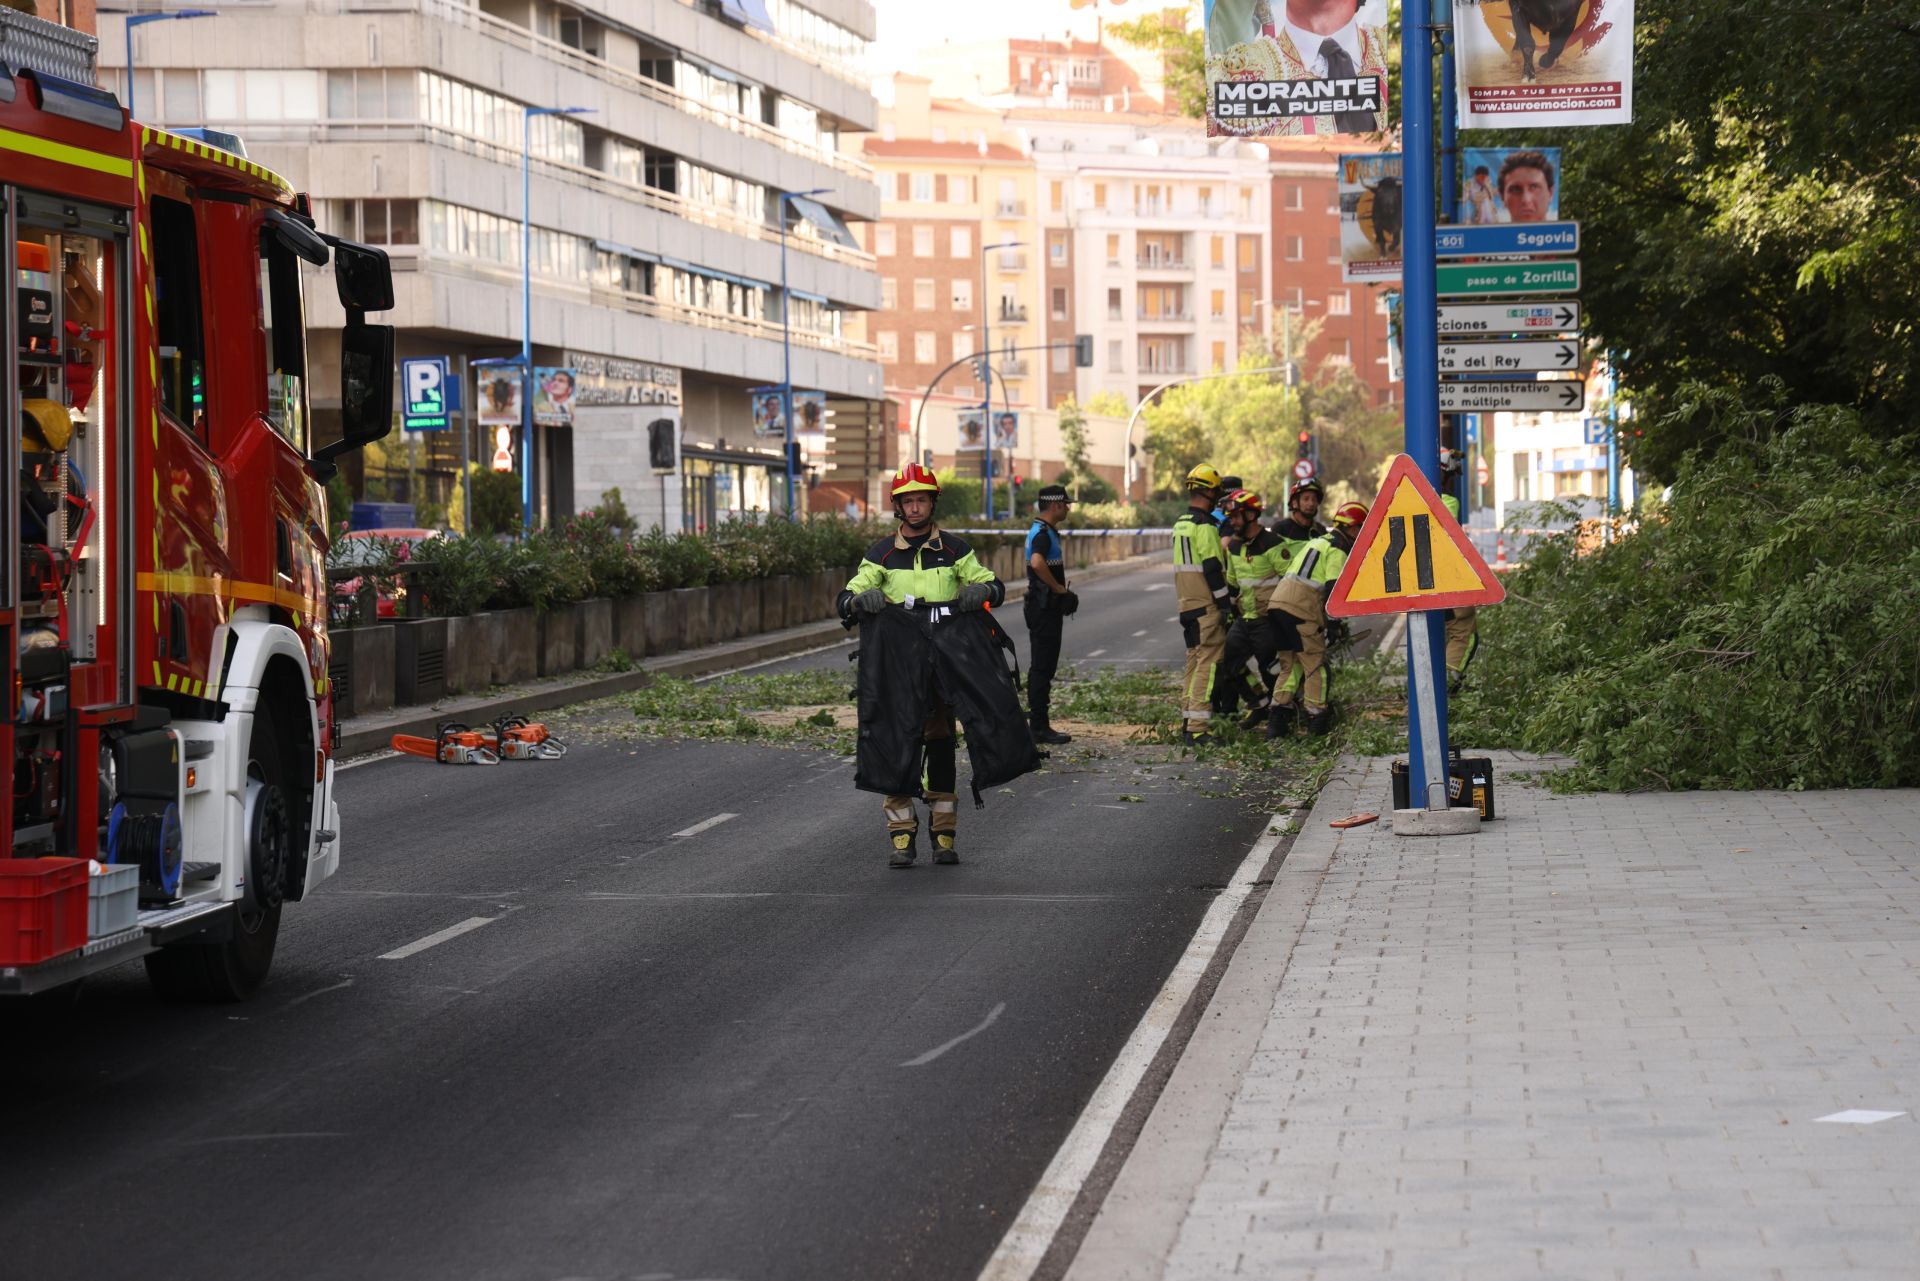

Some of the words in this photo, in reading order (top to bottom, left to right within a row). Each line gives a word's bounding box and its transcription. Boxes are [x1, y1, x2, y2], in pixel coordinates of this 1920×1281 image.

[1218, 77, 1377, 100] MORANTE
[1551, 86, 1614, 94] ENTRADAS
[1218, 103, 1247, 116] DE
[1253, 101, 1282, 115] LA
[1288, 98, 1377, 114] PUEBLA
[1474, 98, 1616, 111] www.tauroemocion.com
[1517, 231, 1574, 246] Segovia
[1467, 277, 1498, 287] paseo
[1504, 275, 1517, 284] de
[1522, 270, 1575, 284] Zorrilla
[1443, 346, 1456, 355] de
[1464, 356, 1486, 368] del
[1495, 356, 1521, 369] Rey
[408, 363, 440, 403] P
[1463, 383, 1550, 393] administrativo
[1461, 396, 1512, 408] múltiple
